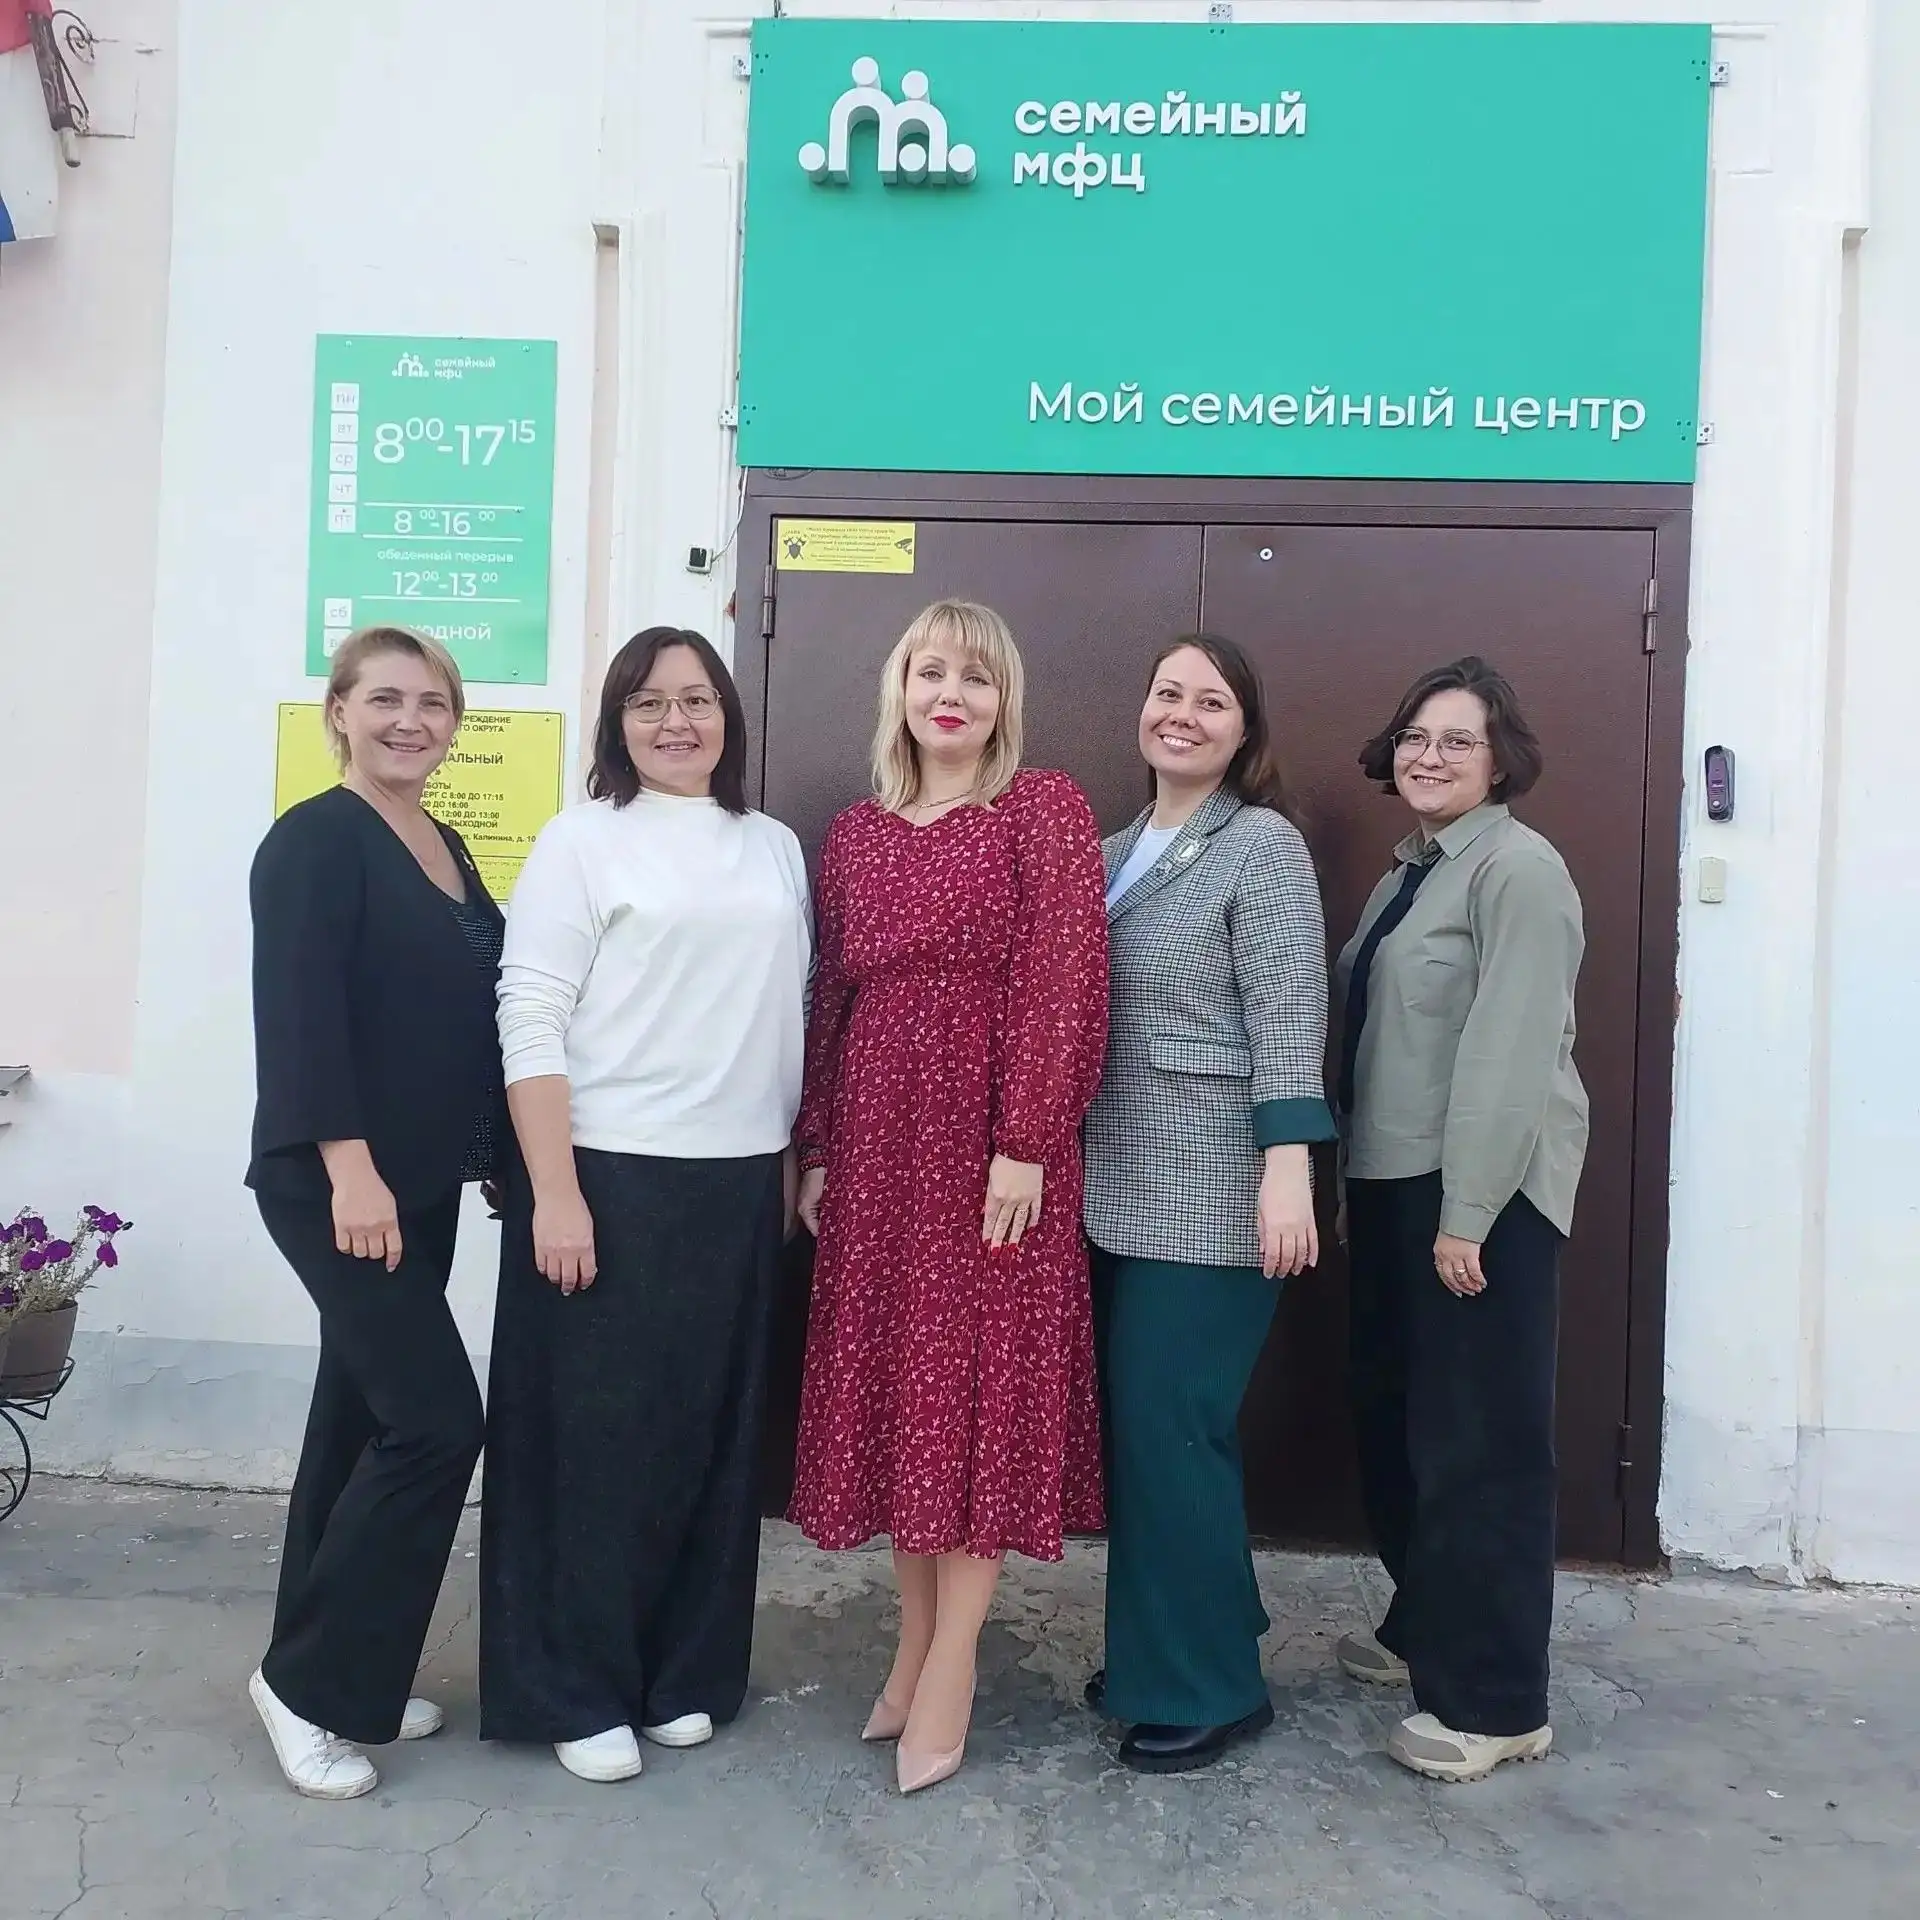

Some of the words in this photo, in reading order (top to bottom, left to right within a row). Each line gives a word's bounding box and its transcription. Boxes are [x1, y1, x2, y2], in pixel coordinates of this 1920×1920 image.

[1015, 90, 1307, 136] семейный
[1013, 141, 1146, 199] мфц
[435, 357, 496, 369] семейный
[1029, 381, 1144, 424] Мой
[1161, 384, 1454, 428] семейный
[1475, 395, 1647, 442] центр
[335, 454, 354, 466] ср
[377, 549, 452, 561] обеденный
[455, 551, 514, 563] перерыв
[463, 715, 512, 724] РЕЖДЕНИЕ
[472, 724, 505, 733] ОКРУГА
[446, 752, 504, 765] АЛЬНЫЙ
[426, 781, 452, 790] БОТЫ
[467, 793, 481, 801] ДО
